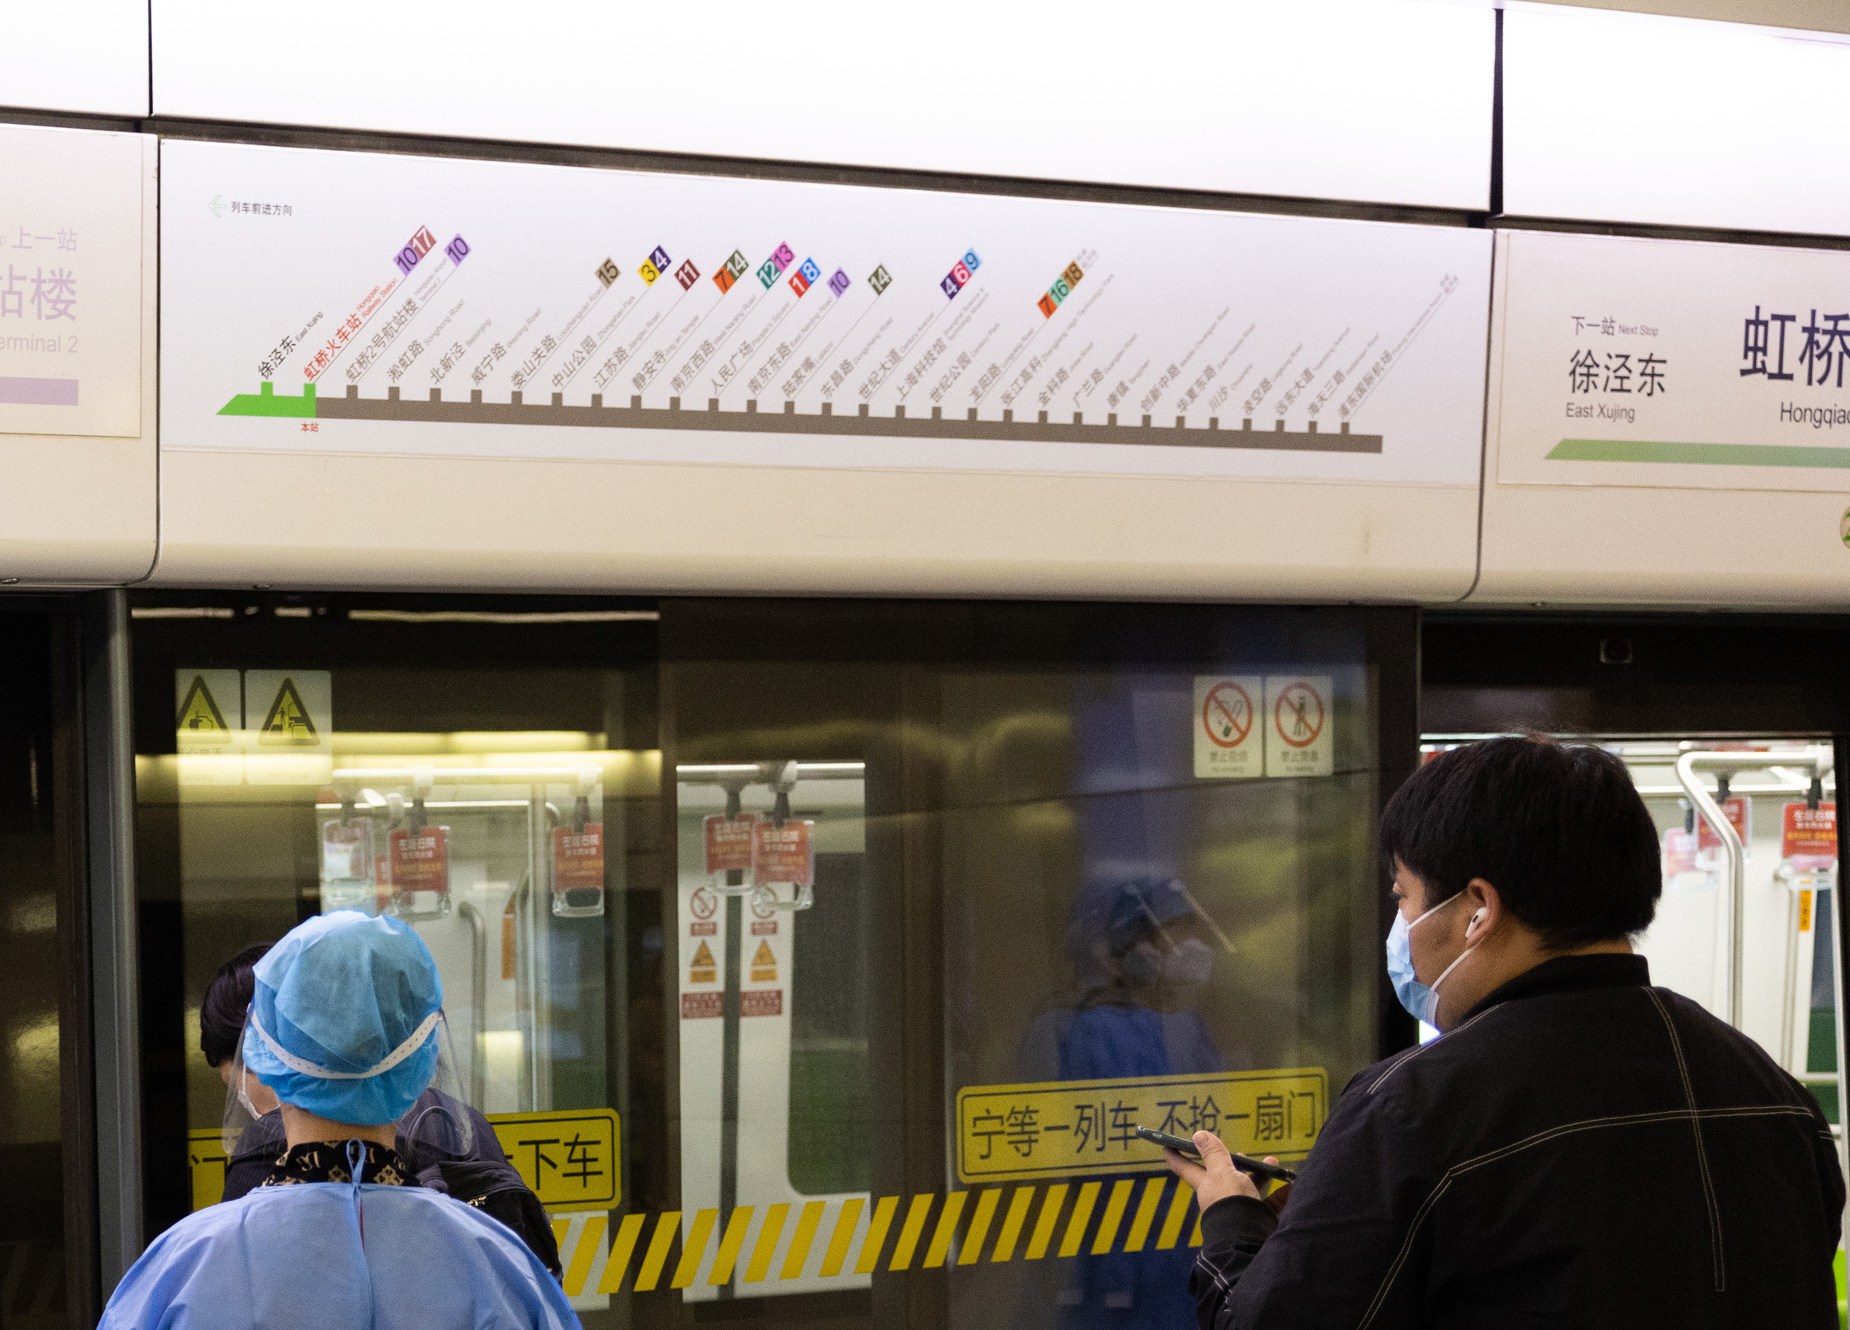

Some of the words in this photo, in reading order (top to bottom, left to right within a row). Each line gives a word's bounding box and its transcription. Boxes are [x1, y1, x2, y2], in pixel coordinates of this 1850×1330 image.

[231, 200, 293, 216] 列车前进方向
[11, 225, 79, 252] 上一站
[396, 247, 418, 272] 10
[412, 228, 432, 254] 17
[448, 237, 469, 262] 10
[598, 260, 619, 285] 15
[678, 262, 698, 287] 11
[726, 252, 747, 277] 14
[759, 261, 777, 286] 12
[774, 244, 794, 269] 13
[830, 270, 849, 295] 10
[870, 269, 890, 292] 14
[1050, 279, 1069, 302] 16
[1063, 263, 1081, 286] 18
[67, 335, 79, 353] 2
[303, 313, 362, 381] 虹桥火车站
[345, 298, 419, 382] 虹桥2号航站楼
[1571, 315, 1616, 337] 下一站
[1618, 324, 1637, 335] Next
[1639, 325, 1659, 337] Stop
[1740, 305, 1850, 388] 虹桥
[258, 335, 297, 380] 徐泾东
[386, 339, 425, 384] 淞虹路
[430, 341, 466, 385] 北新泾
[471, 342, 507, 386] 威宁路
[511, 334, 557, 389] 娄山关路
[551, 335, 598, 387] 中山公园
[592, 346, 629, 388] 江苏路
[670, 339, 715, 393] 南京西路
[711, 340, 753, 394] 人民广场
[747, 342, 792, 395] 南京东路
[1569, 348, 1667, 396] 徐泾东
[301, 422, 319, 433] 本站
[1566, 402, 1593, 419] East
[1597, 404, 1635, 424] Xujing
[971, 1101, 1139, 1160] 宁等一列车
[1156, 1091, 1317, 1142] 不抢一扇门
